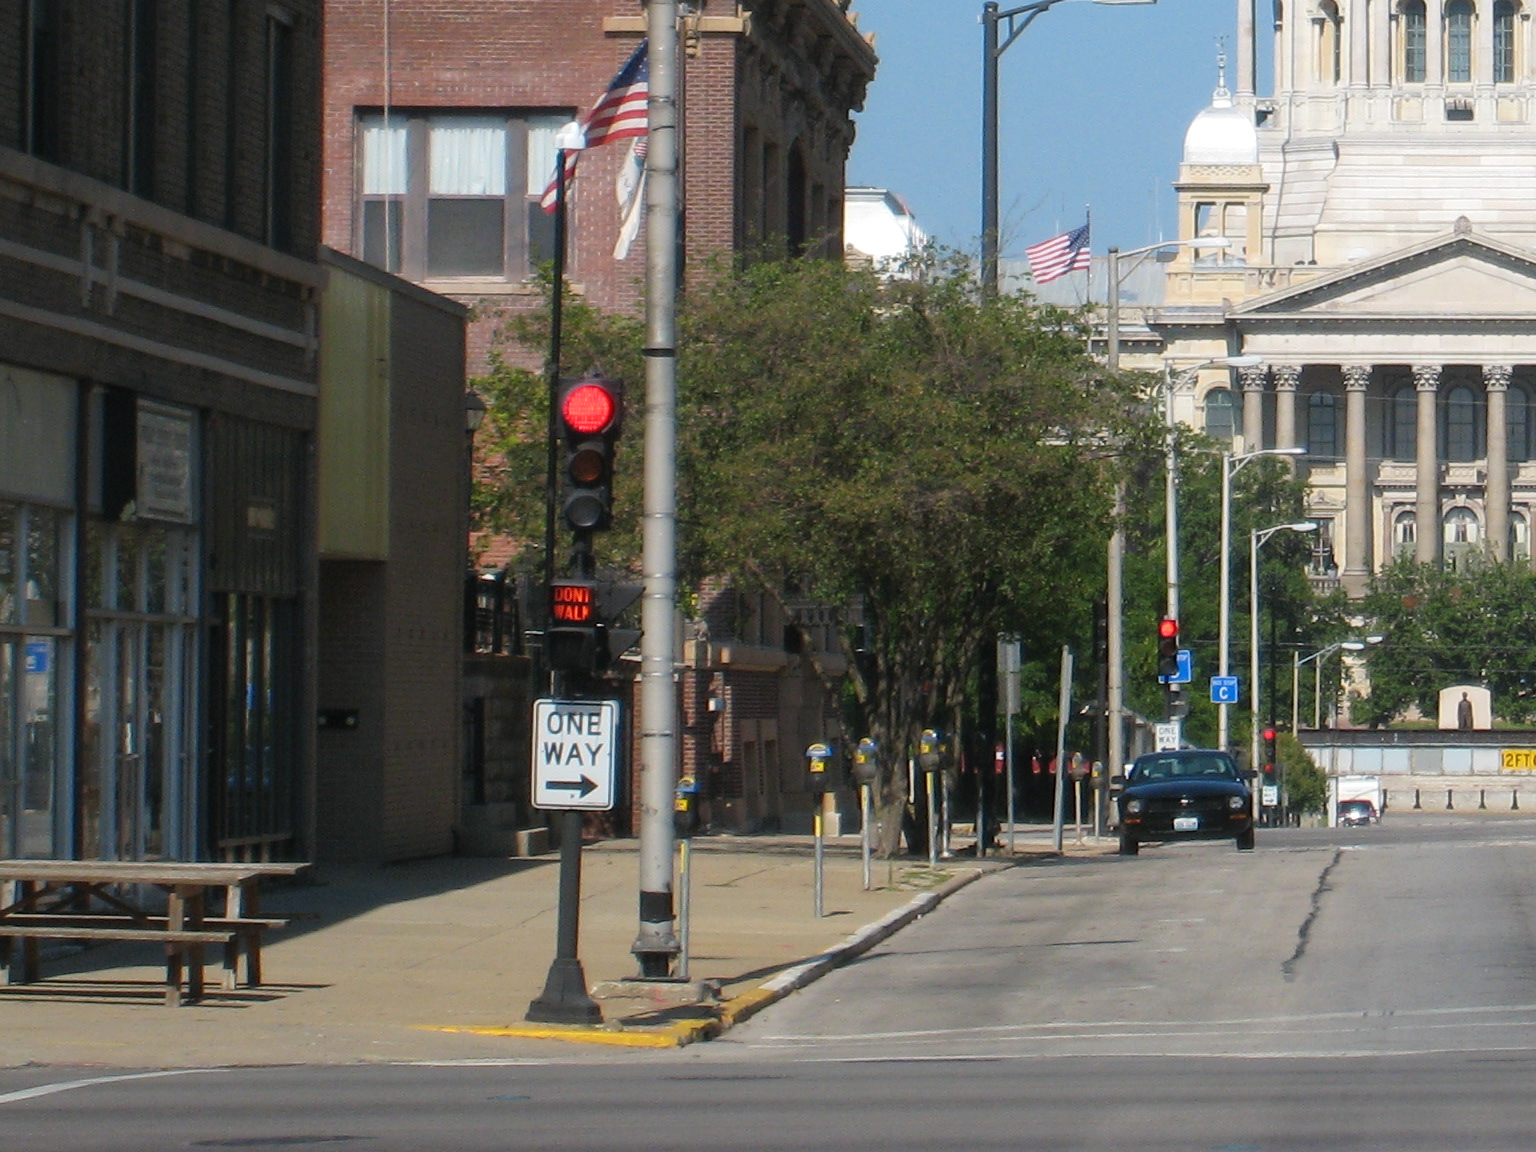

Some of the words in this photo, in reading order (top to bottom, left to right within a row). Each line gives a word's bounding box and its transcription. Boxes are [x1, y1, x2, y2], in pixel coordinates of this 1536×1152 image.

[1219, 686, 1228, 699] C
[547, 711, 602, 735] ONE
[1160, 726, 1176, 735] ONE
[1159, 736, 1176, 744] WAY
[544, 742, 604, 766] WAY
